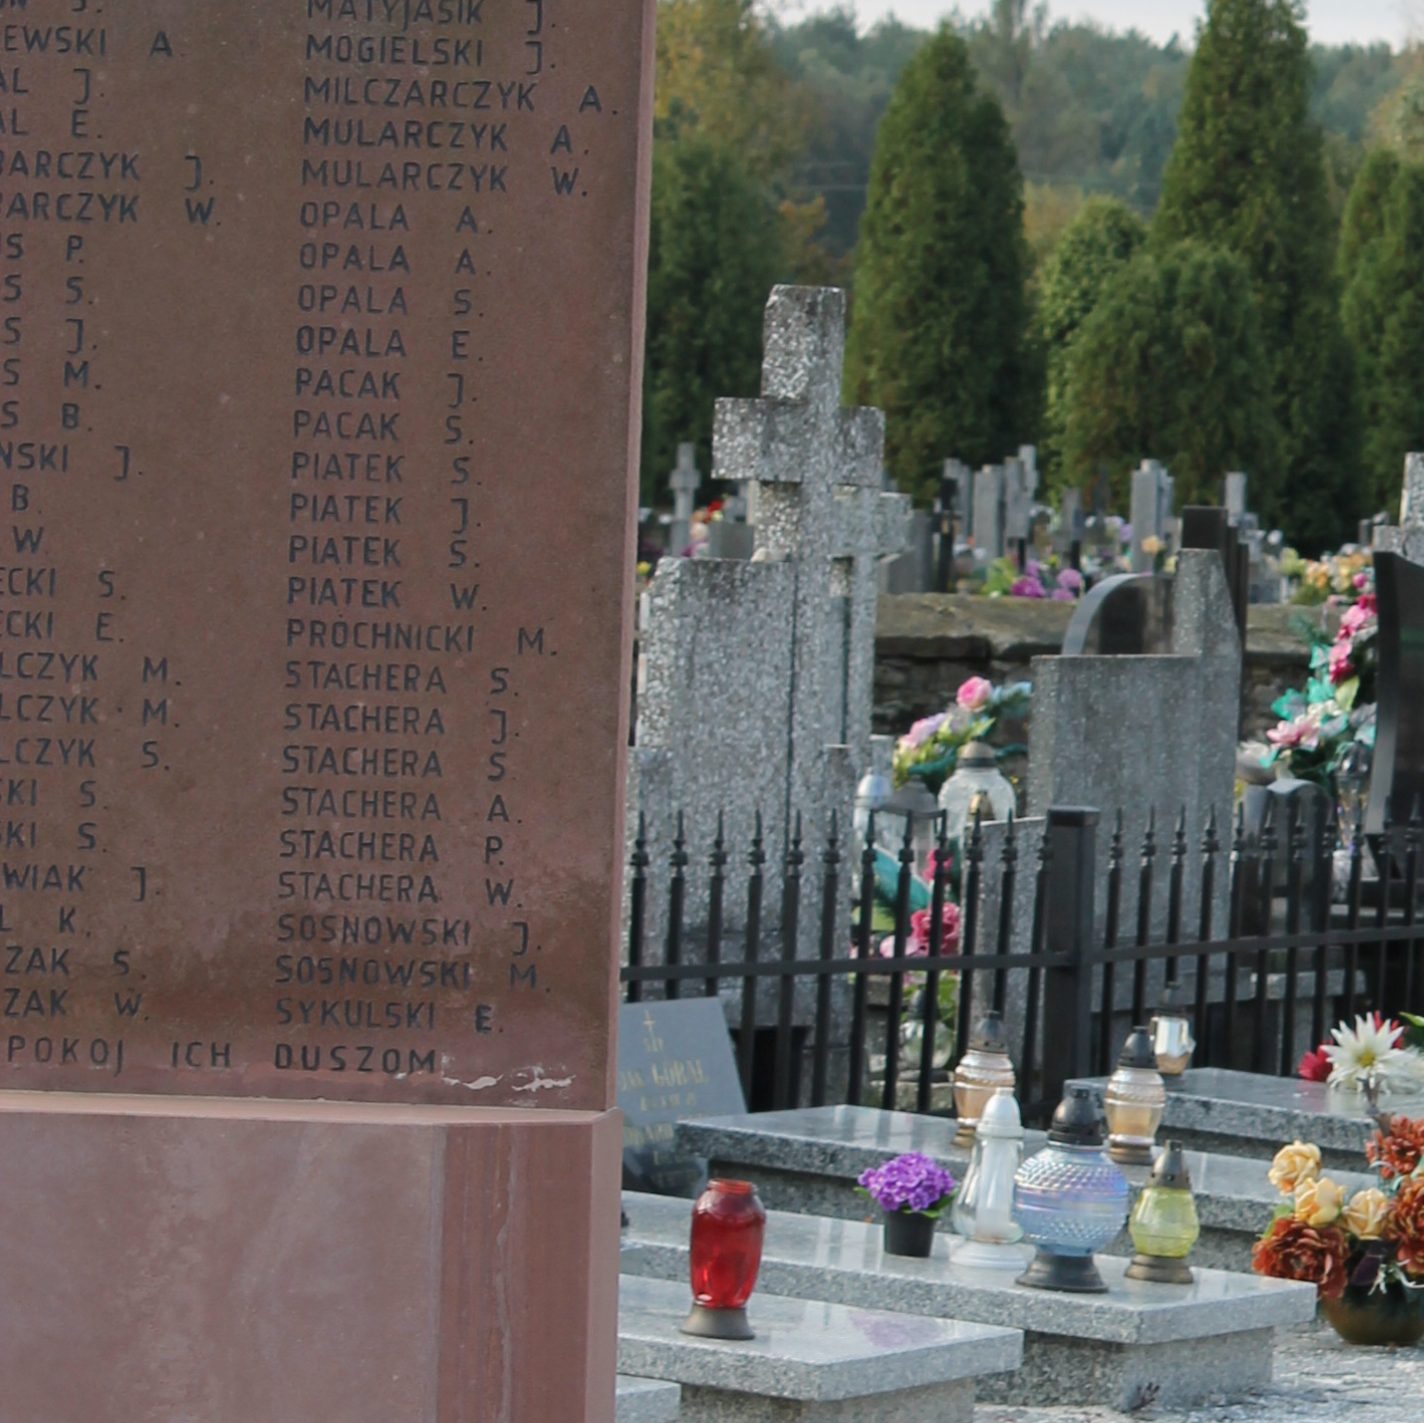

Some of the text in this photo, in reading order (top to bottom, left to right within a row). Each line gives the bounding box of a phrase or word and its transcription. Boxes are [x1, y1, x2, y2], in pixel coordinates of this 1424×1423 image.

[305, 33, 484, 67] MOGIELSKI
[303, 76, 538, 113] MILCZARCZYK
[302, 116, 508, 153] MULARCZYK
[301, 158, 508, 194] MULARCZYK
[300, 201, 410, 232] OPALA
[299, 242, 411, 275] OPALA
[297, 284, 409, 316] OPALA
[295, 325, 407, 358] OPALA
[295, 367, 401, 400] PACAK
[293, 409, 401, 441] PACAK
[290, 451, 406, 486] PIATEK
[290, 492, 403, 524] PIATEK
[288, 534, 402, 567] PIATEK
[286, 576, 402, 609] PIATEK
[284, 660, 447, 695] STACHERA
[284, 703, 446, 735] STACHERA
[282, 744, 443, 778] STACHERA
[280, 785, 442, 821] STACHERA
[278, 828, 439, 863] STACHERA
[277, 870, 439, 904] STACHERA
[276, 912, 472, 947] SOSNOWSKI
[274, 954, 472, 992] SOSNOWSKI
[274, 996, 436, 1031] SYKULSKI
[170, 1040, 231, 1069] ICH
[273, 1042, 437, 1075] DUSZOM
